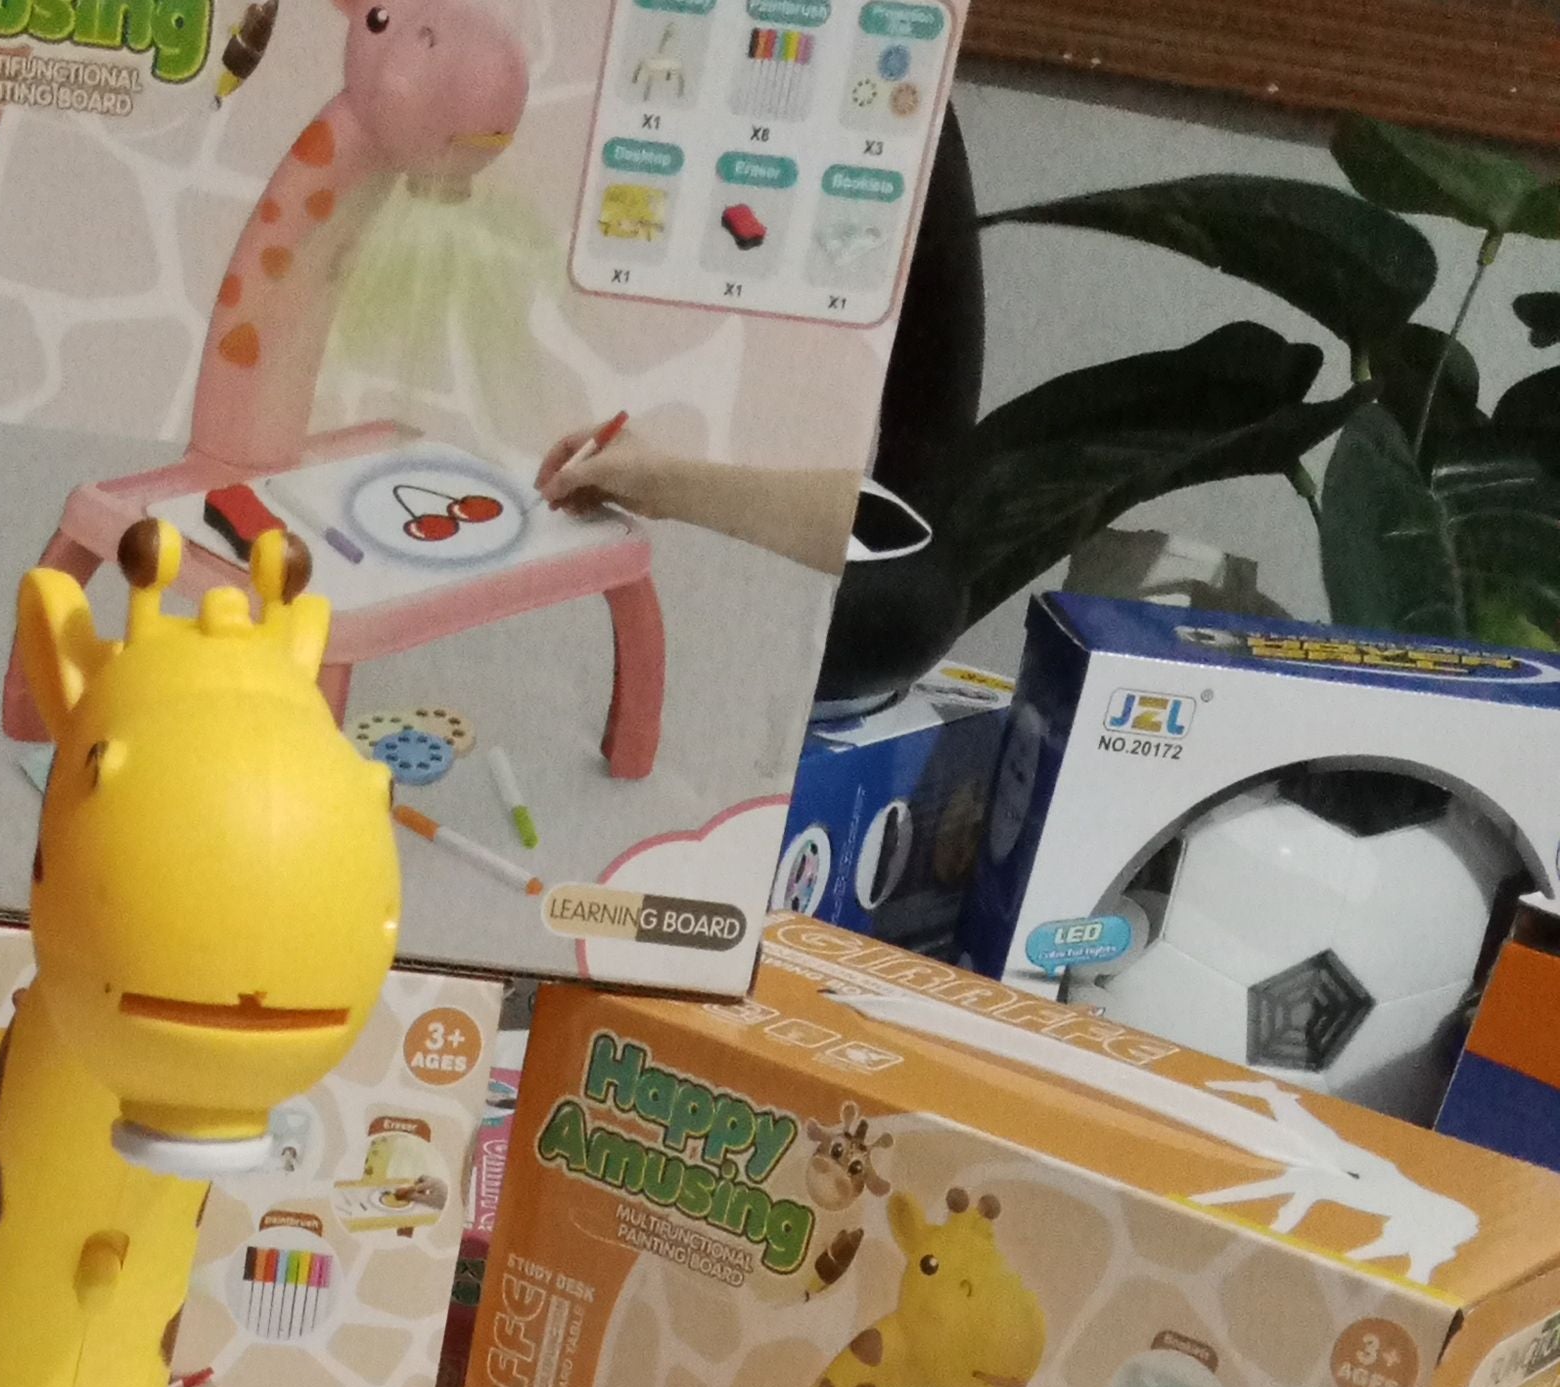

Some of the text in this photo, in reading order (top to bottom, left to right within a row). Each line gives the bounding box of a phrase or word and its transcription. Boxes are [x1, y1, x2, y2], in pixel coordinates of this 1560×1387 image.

[56, 84, 133, 116] BOARD
[643, 114, 661, 130] X1
[864, 140, 884, 156] X3
[612, 269, 630, 284] X1
[725, 282, 742, 297] X1
[828, 296, 847, 311] X1
[1098, 735, 1184, 761] NO.20172
[550, 897, 741, 940] LEARNING BOARD
[1053, 923, 1104, 945] LED
[424, 1022, 466, 1050] 3+
[410, 1052, 468, 1072] AGES
[584, 1032, 799, 1184] Happy
[537, 1100, 816, 1275] Amusing
[616, 1204, 754, 1272] MULTIFUNCTIONAL
[617, 1224, 745, 1288] PAINTING BOARD
[507, 1253, 595, 1303] STUDY DESK
[1357, 1332, 1402, 1367] 3+
